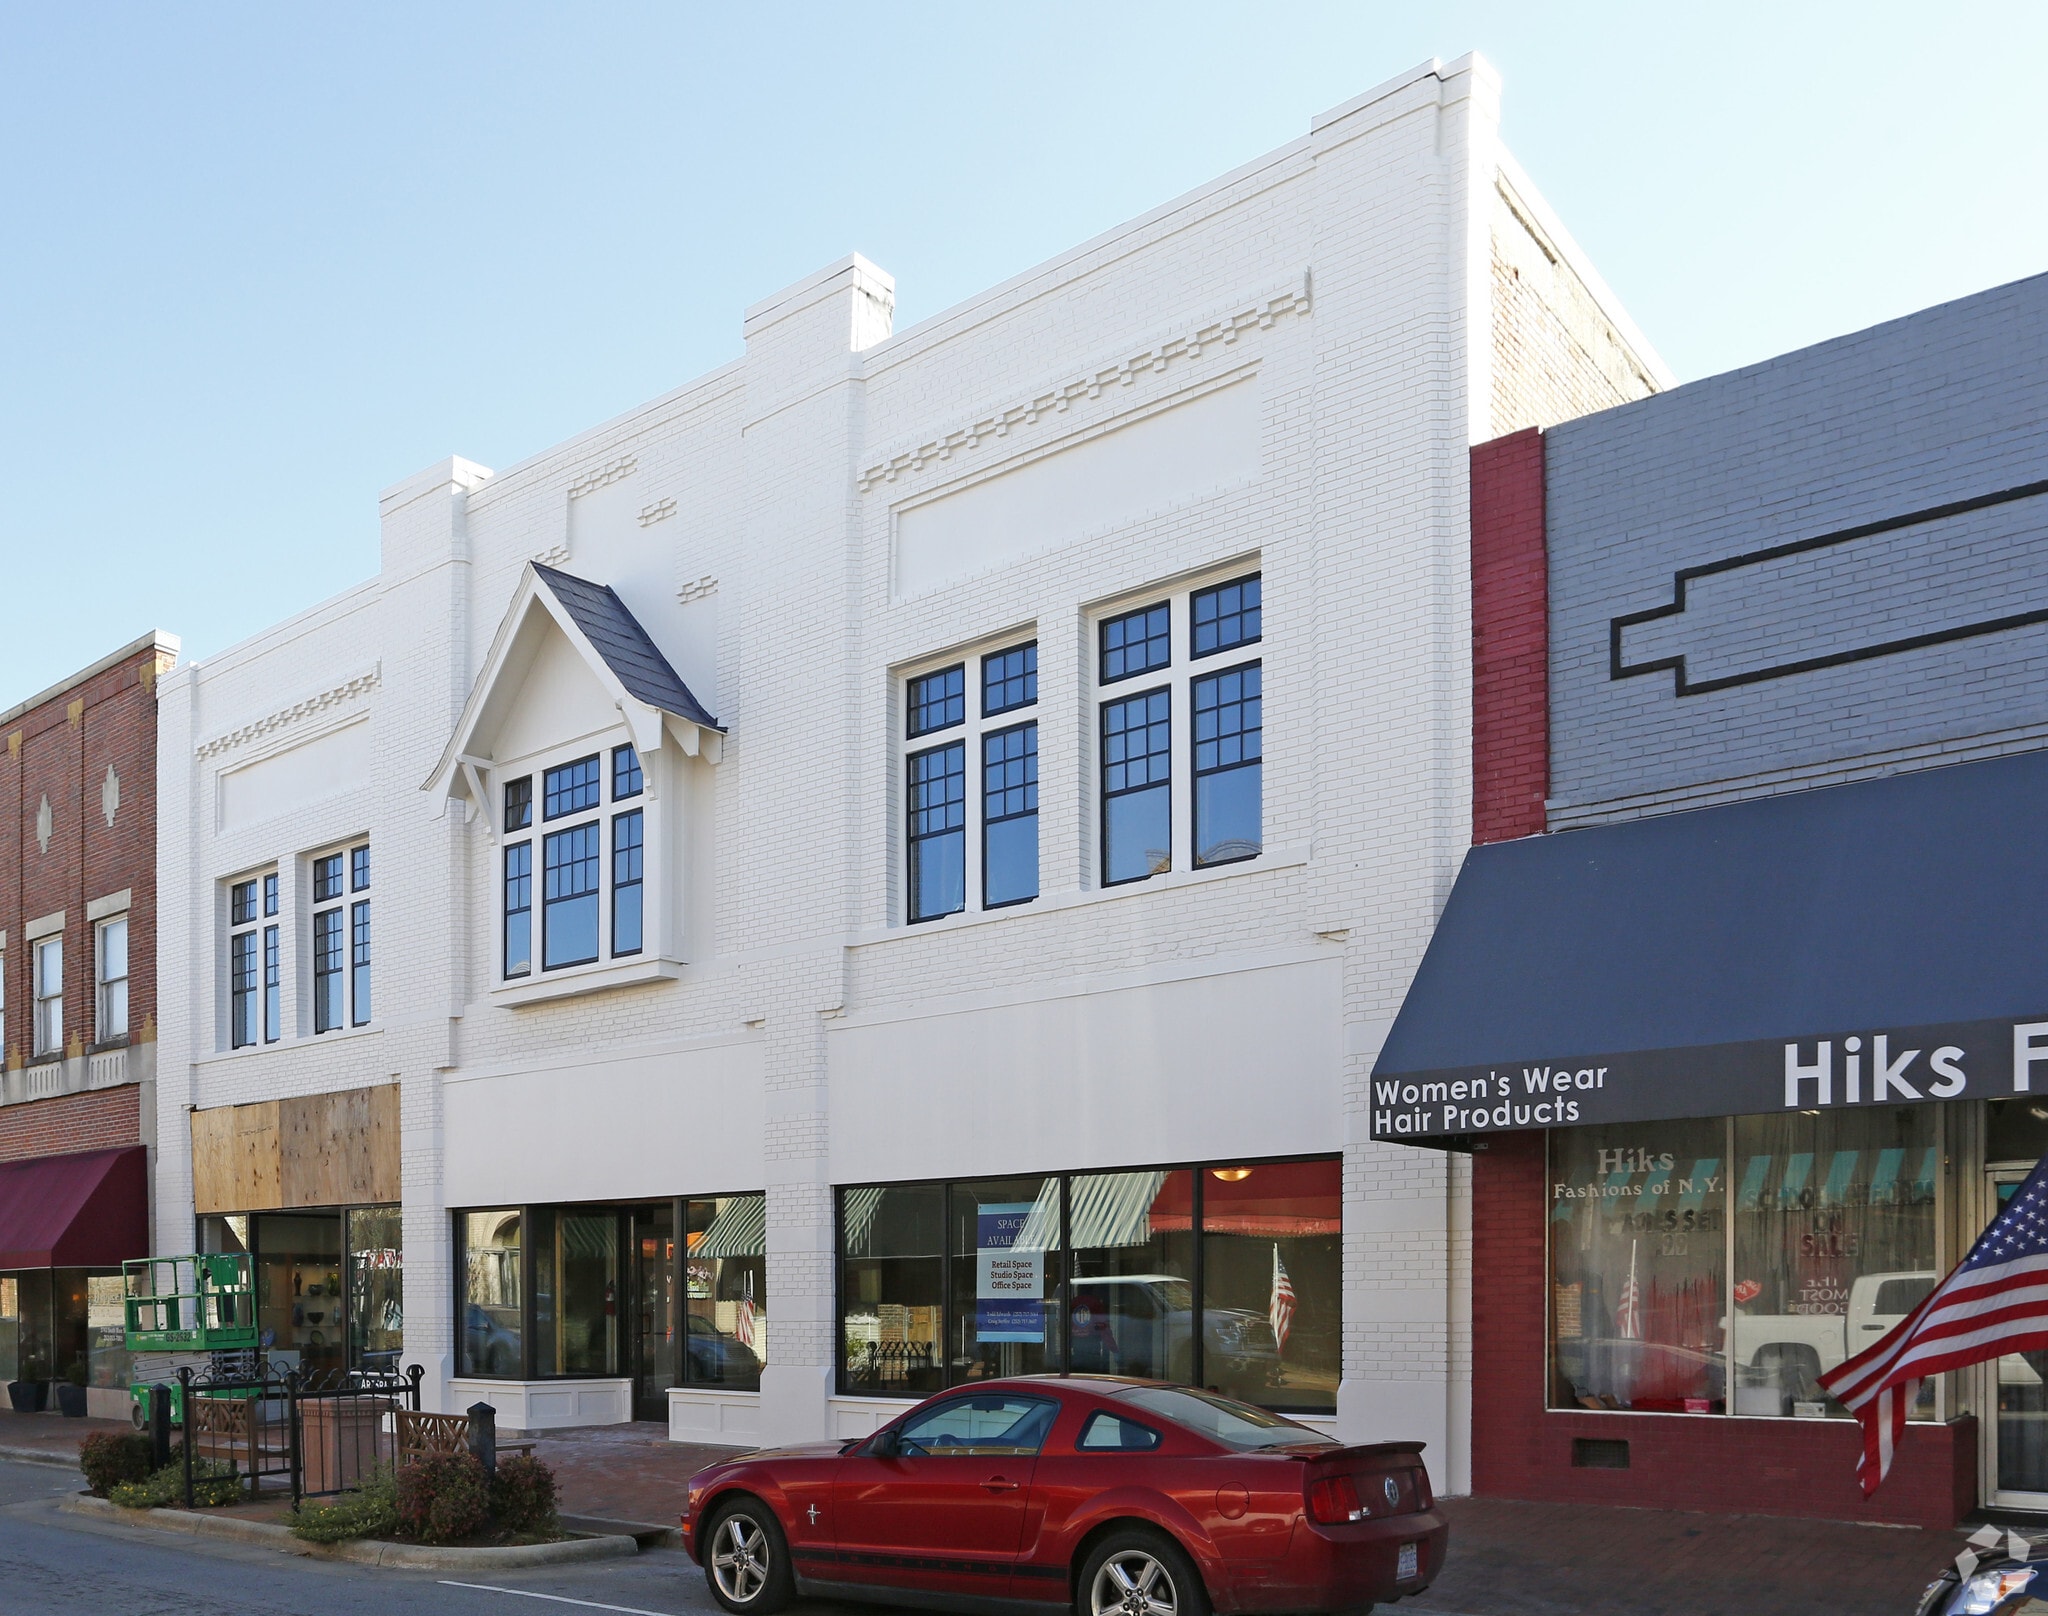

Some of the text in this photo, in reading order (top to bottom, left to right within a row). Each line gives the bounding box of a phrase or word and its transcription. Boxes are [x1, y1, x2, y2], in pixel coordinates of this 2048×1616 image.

[1784, 1035, 1967, 1107] Hiks
[1375, 1066, 1608, 1106] Women's Wear
[1375, 1096, 1580, 1134] Hair Products
[1597, 1147, 1675, 1174] Hiks
[1554, 1183, 1643, 1199] Fashions
[1652, 1180, 1671, 1195] of
[998, 1219, 1025, 1230] SPACE
[1012, 1261, 1032, 1269] Space
[991, 1271, 1033, 1280] Studio Space
[992, 1281, 1032, 1290] Office Space
